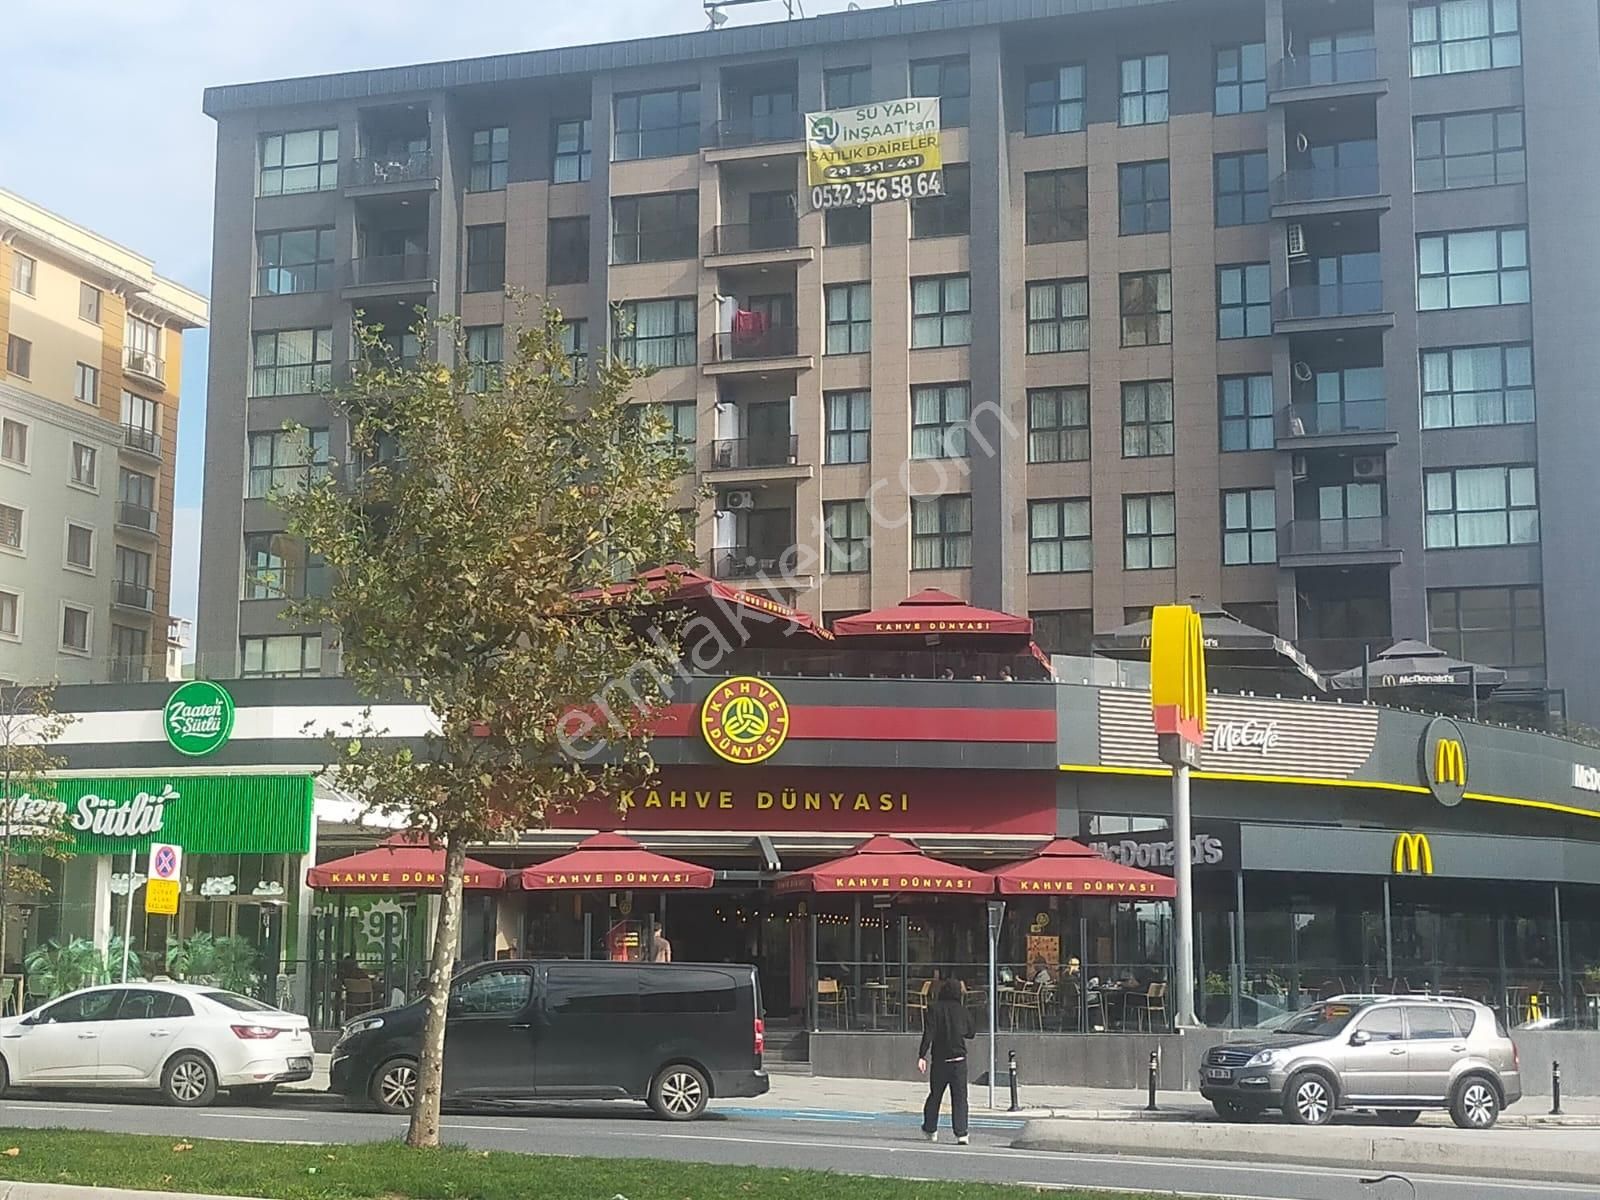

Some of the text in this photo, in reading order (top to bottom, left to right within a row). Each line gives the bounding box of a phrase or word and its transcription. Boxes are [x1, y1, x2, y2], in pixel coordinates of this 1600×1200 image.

[856, 102, 921, 122] SU YAPI
[811, 136, 937, 162] SATILIK DAİRELER
[829, 166, 851, 177] 2+1
[863, 161, 884, 173] 3+1
[812, 172, 941, 209] 0532 356 58 64
[876, 620, 991, 631] KAHVE DÜNYASI
[1399, 674, 1455, 684] McDonald's
[710, 682, 779, 712] KAHVE
[169, 701, 222, 722] Zaaten
[182, 717, 221, 733] Sütlü
[710, 728, 780, 758] DÜNYASI
[620, 788, 908, 811] KAHVE DÜNYASI
[71, 791, 165, 836] Sütlü
[332, 873, 391, 882] KAHVE
[546, 872, 690, 884] KAHVE DÜNYASI
[836, 876, 972, 889] KAHVE DÜNYASI
[1020, 880, 1156, 893] KAHVE DÜNYASI
